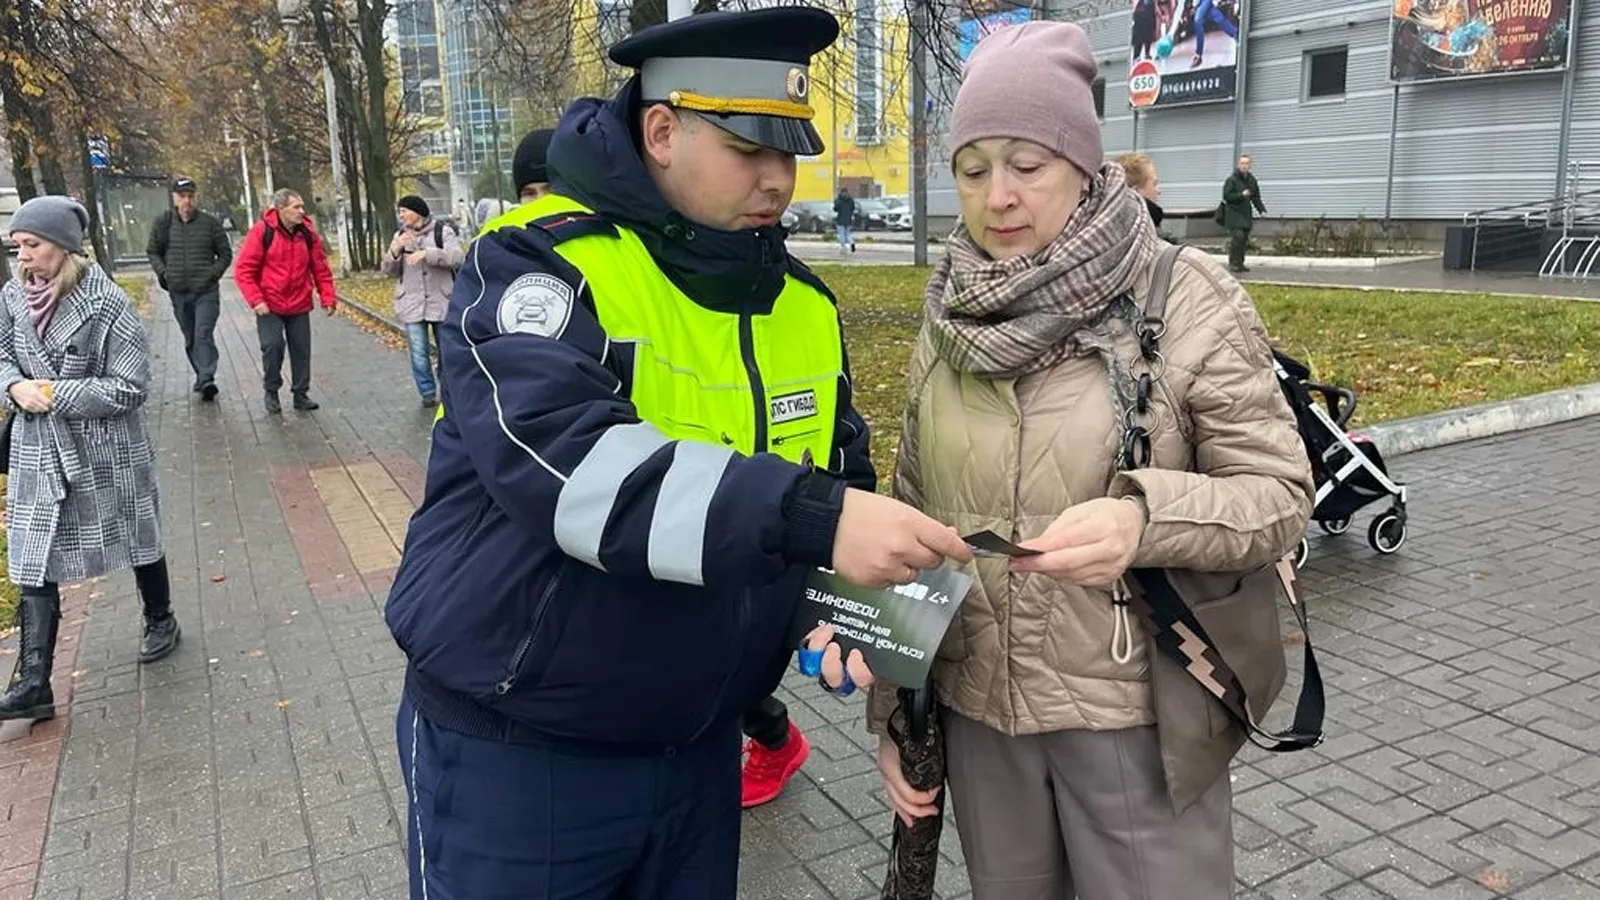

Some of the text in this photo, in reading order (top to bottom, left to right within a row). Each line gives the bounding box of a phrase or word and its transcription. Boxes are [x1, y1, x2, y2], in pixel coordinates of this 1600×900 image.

[1133, 76, 1154, 90] 650
[805, 588, 880, 619] ПОЗВОНИТЕ:
[928, 591, 949, 605] +7
[875, 637, 897, 651] МОЙ
[898, 645, 925, 660] ЕСЛИ
